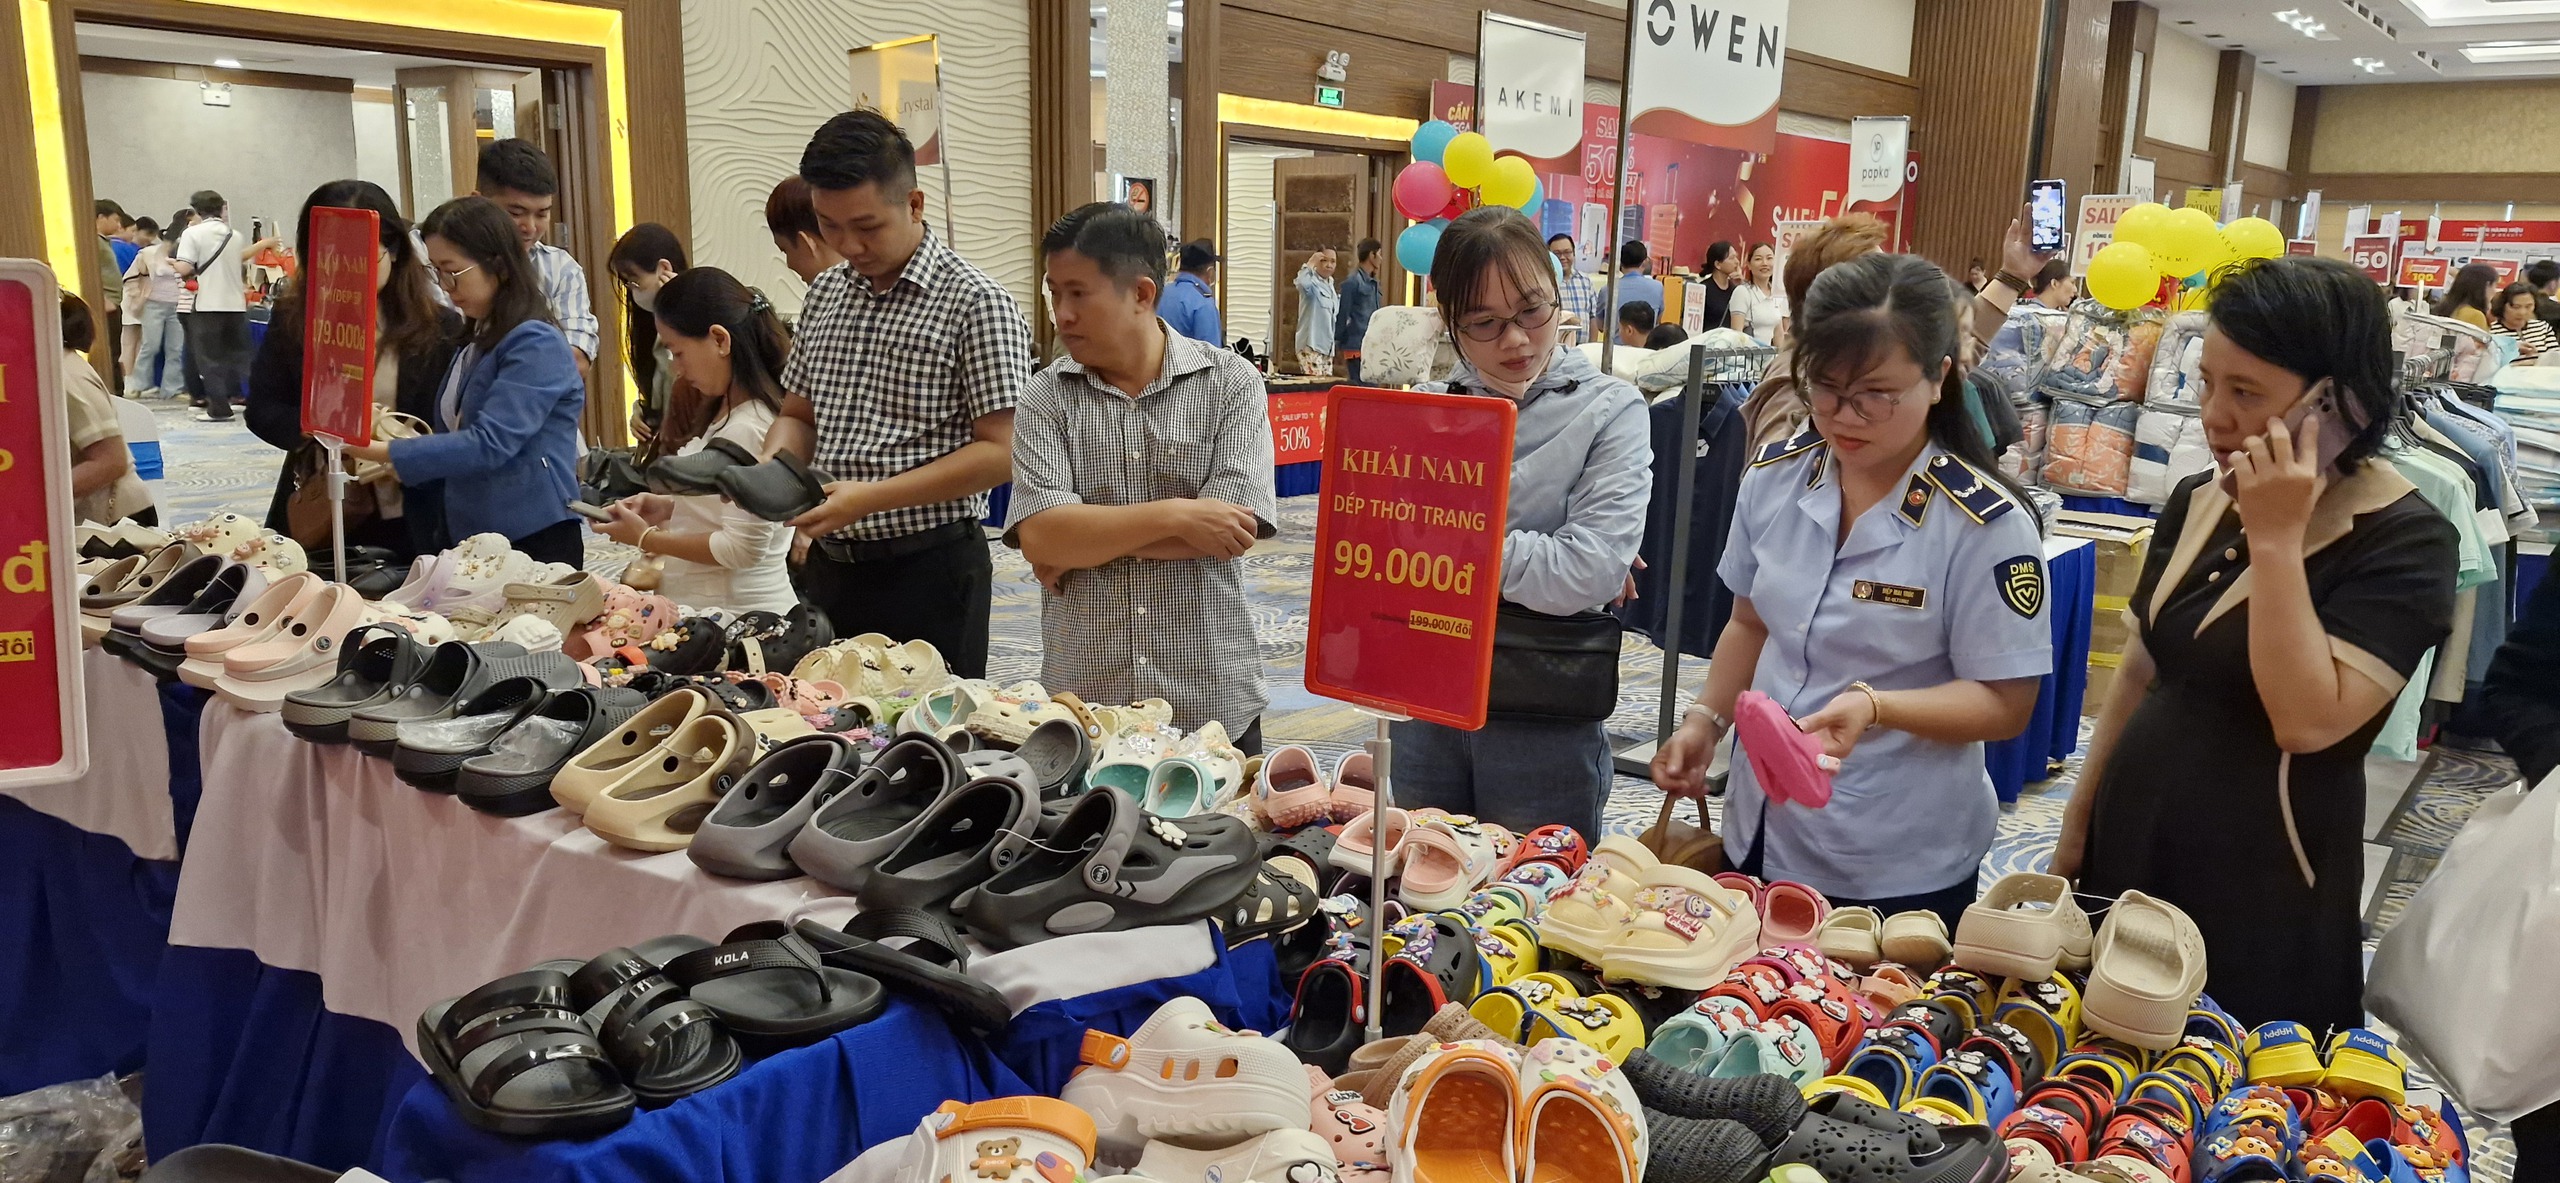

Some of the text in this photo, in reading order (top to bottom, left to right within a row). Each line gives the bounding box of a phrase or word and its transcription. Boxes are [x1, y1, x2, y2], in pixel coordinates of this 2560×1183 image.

[1646, 0, 1778, 69] OWEN
[897, 94, 934, 118] Crystal
[1498, 87, 1572, 118] AKEMI
[1862, 165, 1889, 182] papka
[2354, 251, 2388, 269] 50
[1280, 426, 1310, 452] 50%
[1341, 445, 1487, 487] KHẢI NAM
[1333, 491, 1487, 532] DÉP THỜI TRANG
[1333, 540, 1476, 596] 99.000đ
[2009, 561, 2035, 575] DMS
[1410, 614, 1472, 637] 199.000/đôi
[714, 951, 749, 966] KOLA
[2264, 1027, 2293, 1040] HAPPY
[2353, 1034, 2384, 1051] HAPPY
